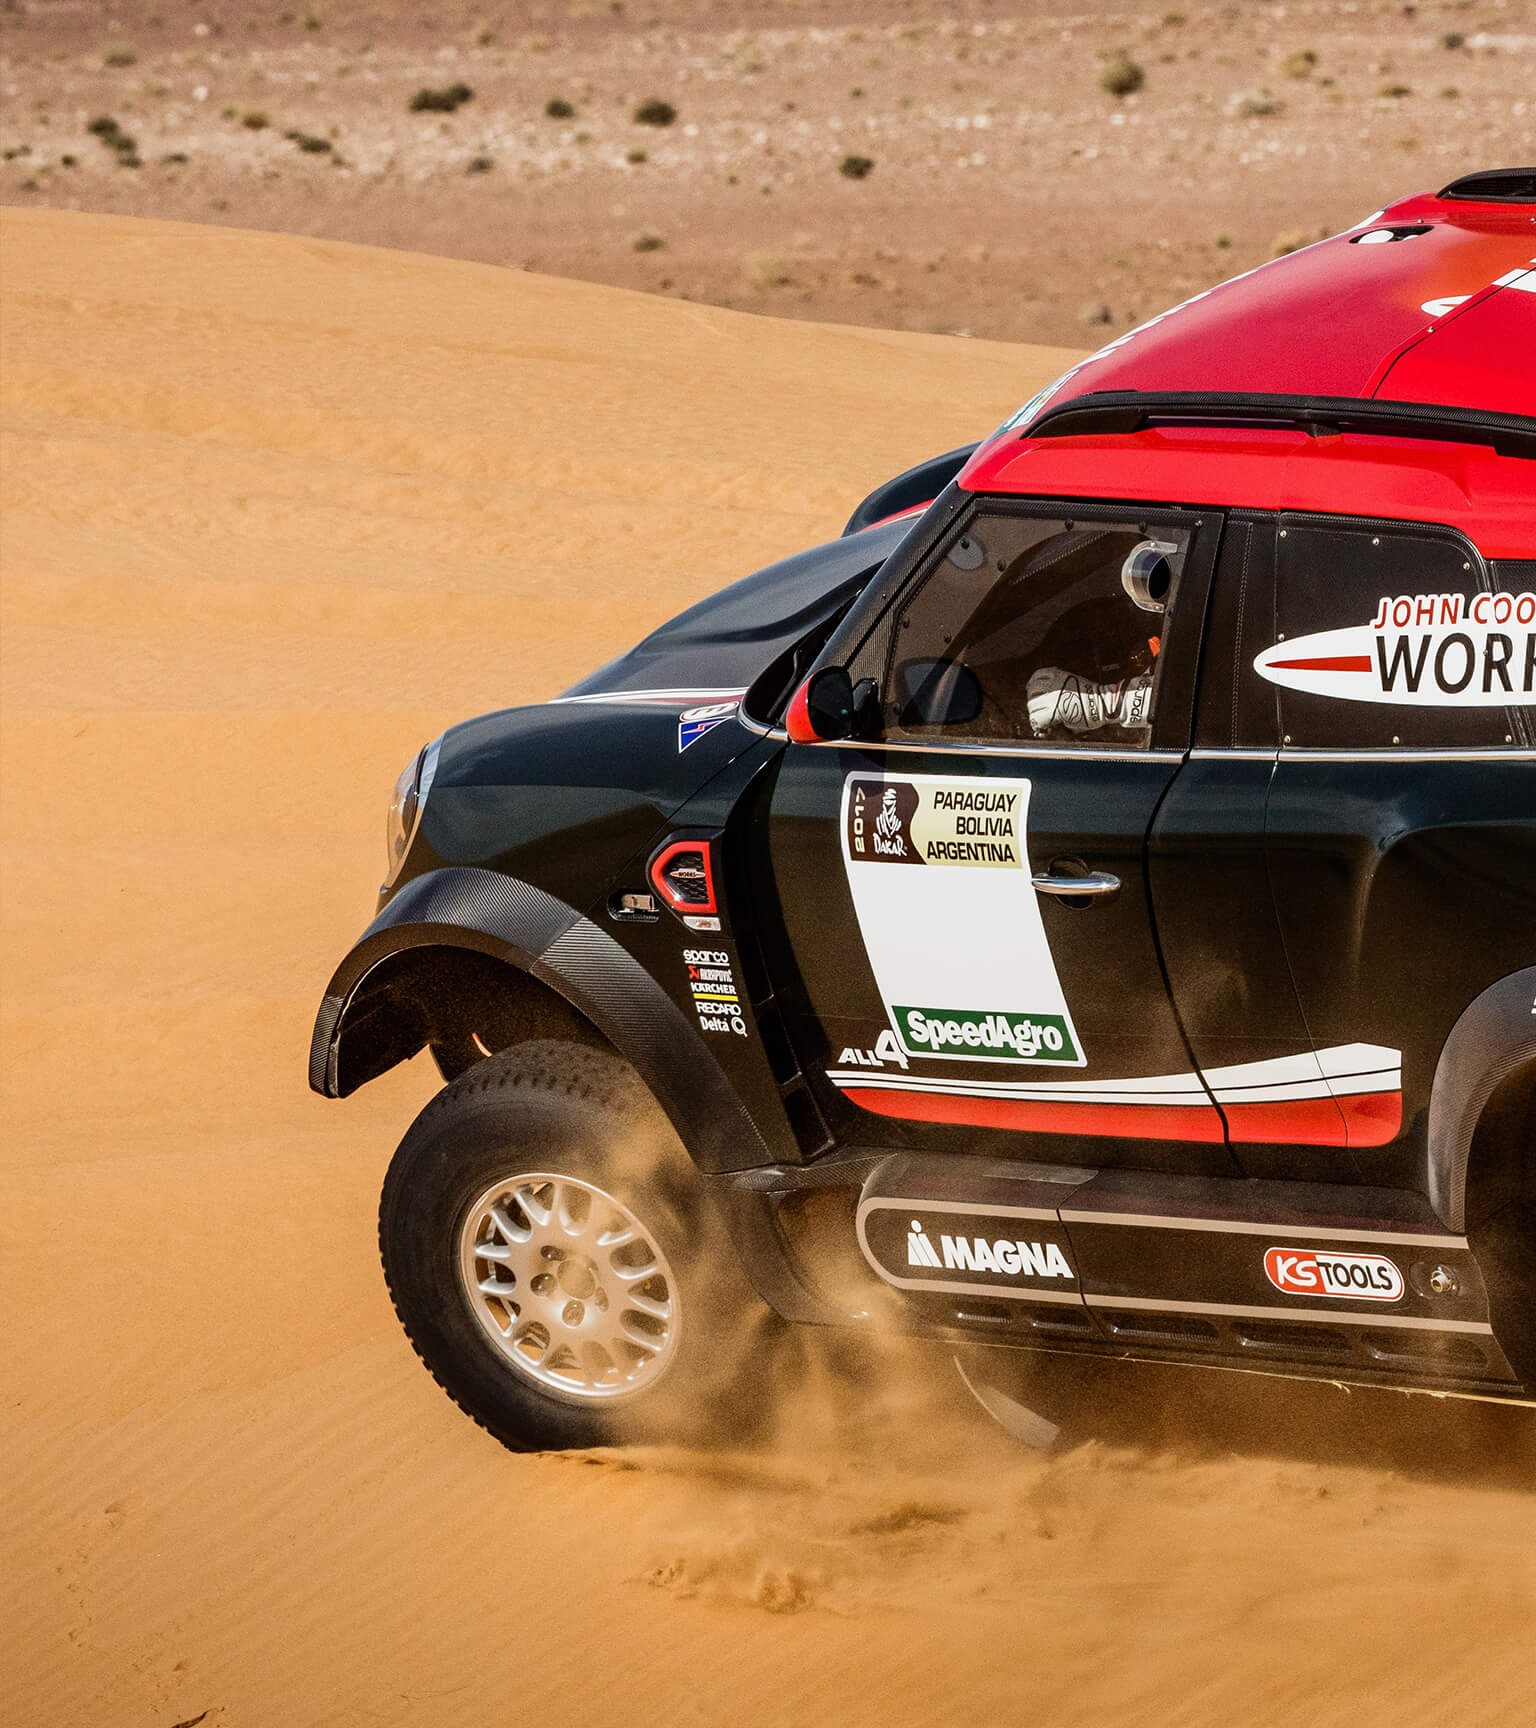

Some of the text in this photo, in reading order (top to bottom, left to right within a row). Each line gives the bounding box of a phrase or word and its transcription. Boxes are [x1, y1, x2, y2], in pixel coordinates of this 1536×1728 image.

[1374, 598, 1460, 630] JOHN
[933, 791, 1017, 813] PARAGUAY
[853, 786, 866, 853] 2017
[956, 816, 1014, 837] BOLIVIA
[873, 832, 907, 857] DAKAR
[926, 840, 1016, 863] ARGENTINA
[683, 949, 729, 965] sparco
[695, 1001, 742, 1016] RECARO
[699, 1015, 730, 1032] Delta
[906, 1010, 1064, 1057] SpeedAgro
[837, 1029, 910, 1070] ALL4
[940, 1234, 1075, 1279] MAGNA
[1275, 1255, 1395, 1292] KS TOOLS
